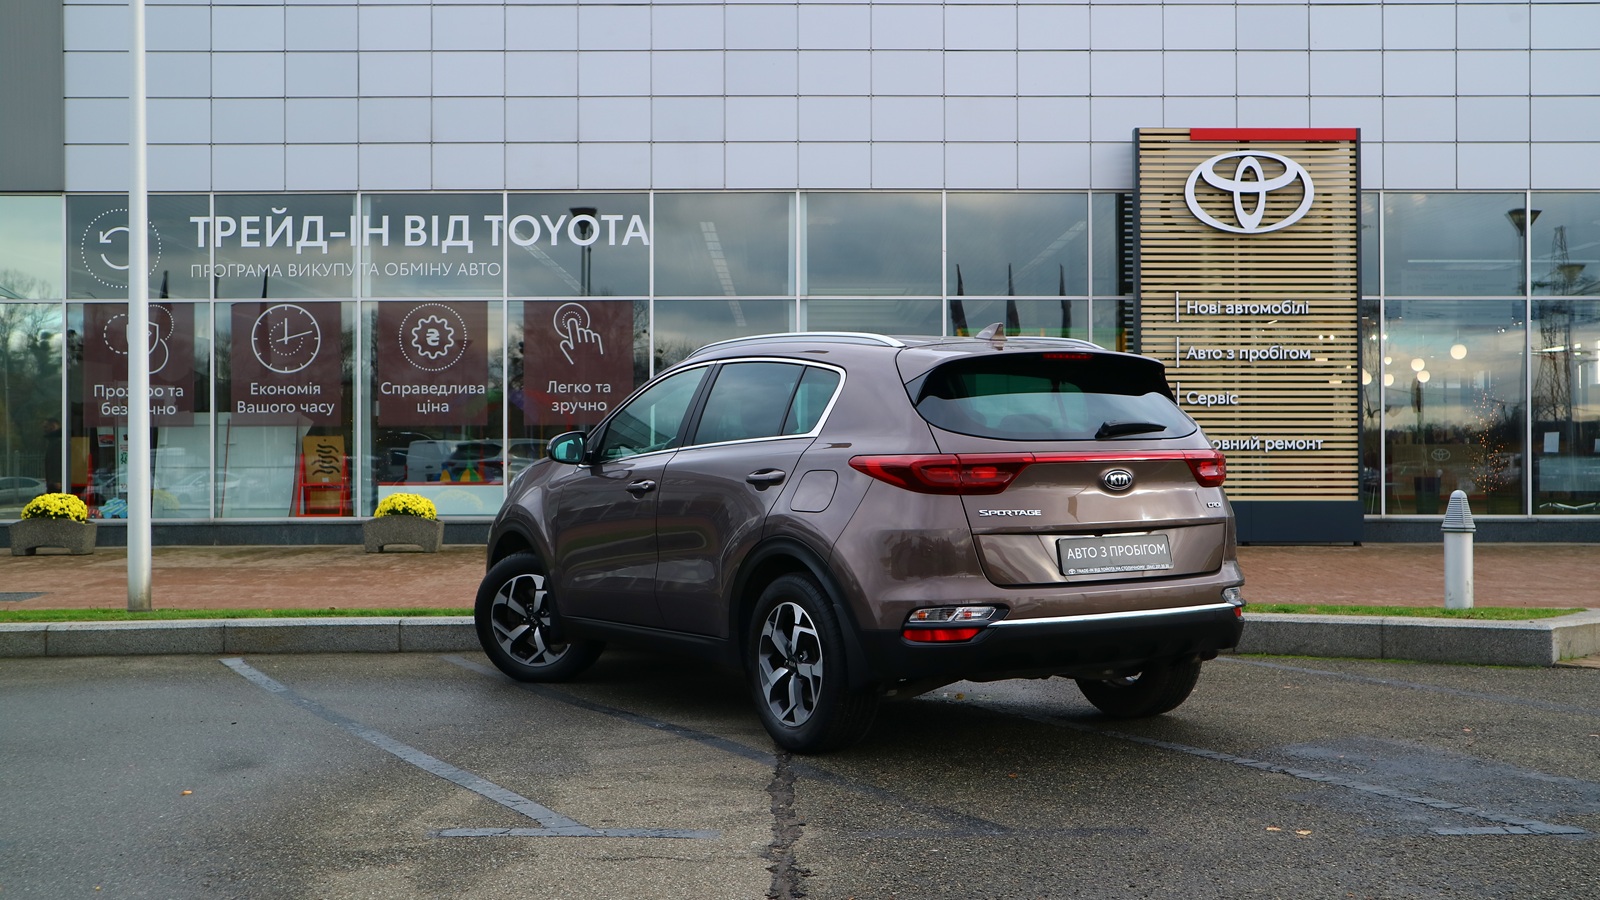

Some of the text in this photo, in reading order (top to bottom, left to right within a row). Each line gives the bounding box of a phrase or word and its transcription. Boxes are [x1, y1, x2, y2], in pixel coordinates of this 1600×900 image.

[190, 208, 649, 254] ТРЕЙД-ІН ВІД TOYOTA
[191, 262, 502, 278] ПРОГРАМА ВИКУПУ ТА ОБМІНУ АВТО
[1187, 301, 1309, 314] Нові автомобілі
[1186, 346, 1311, 362] Авто з пробігом
[168, 386, 184, 397] та
[249, 382, 321, 395] Економія
[381, 381, 485, 398] Справедлива
[547, 381, 611, 396] Легко та
[1186, 391, 1238, 408] Сервіс
[101, 402, 176, 415] безчно
[237, 401, 335, 417] Вашого часу
[417, 401, 450, 414] ціна
[551, 401, 608, 415] зручно
[1211, 436, 1323, 453] овний ремонт
[979, 509, 1042, 518] SPORTAGE
[1067, 543, 1166, 560] АВТО З ПРОБІГОМ
